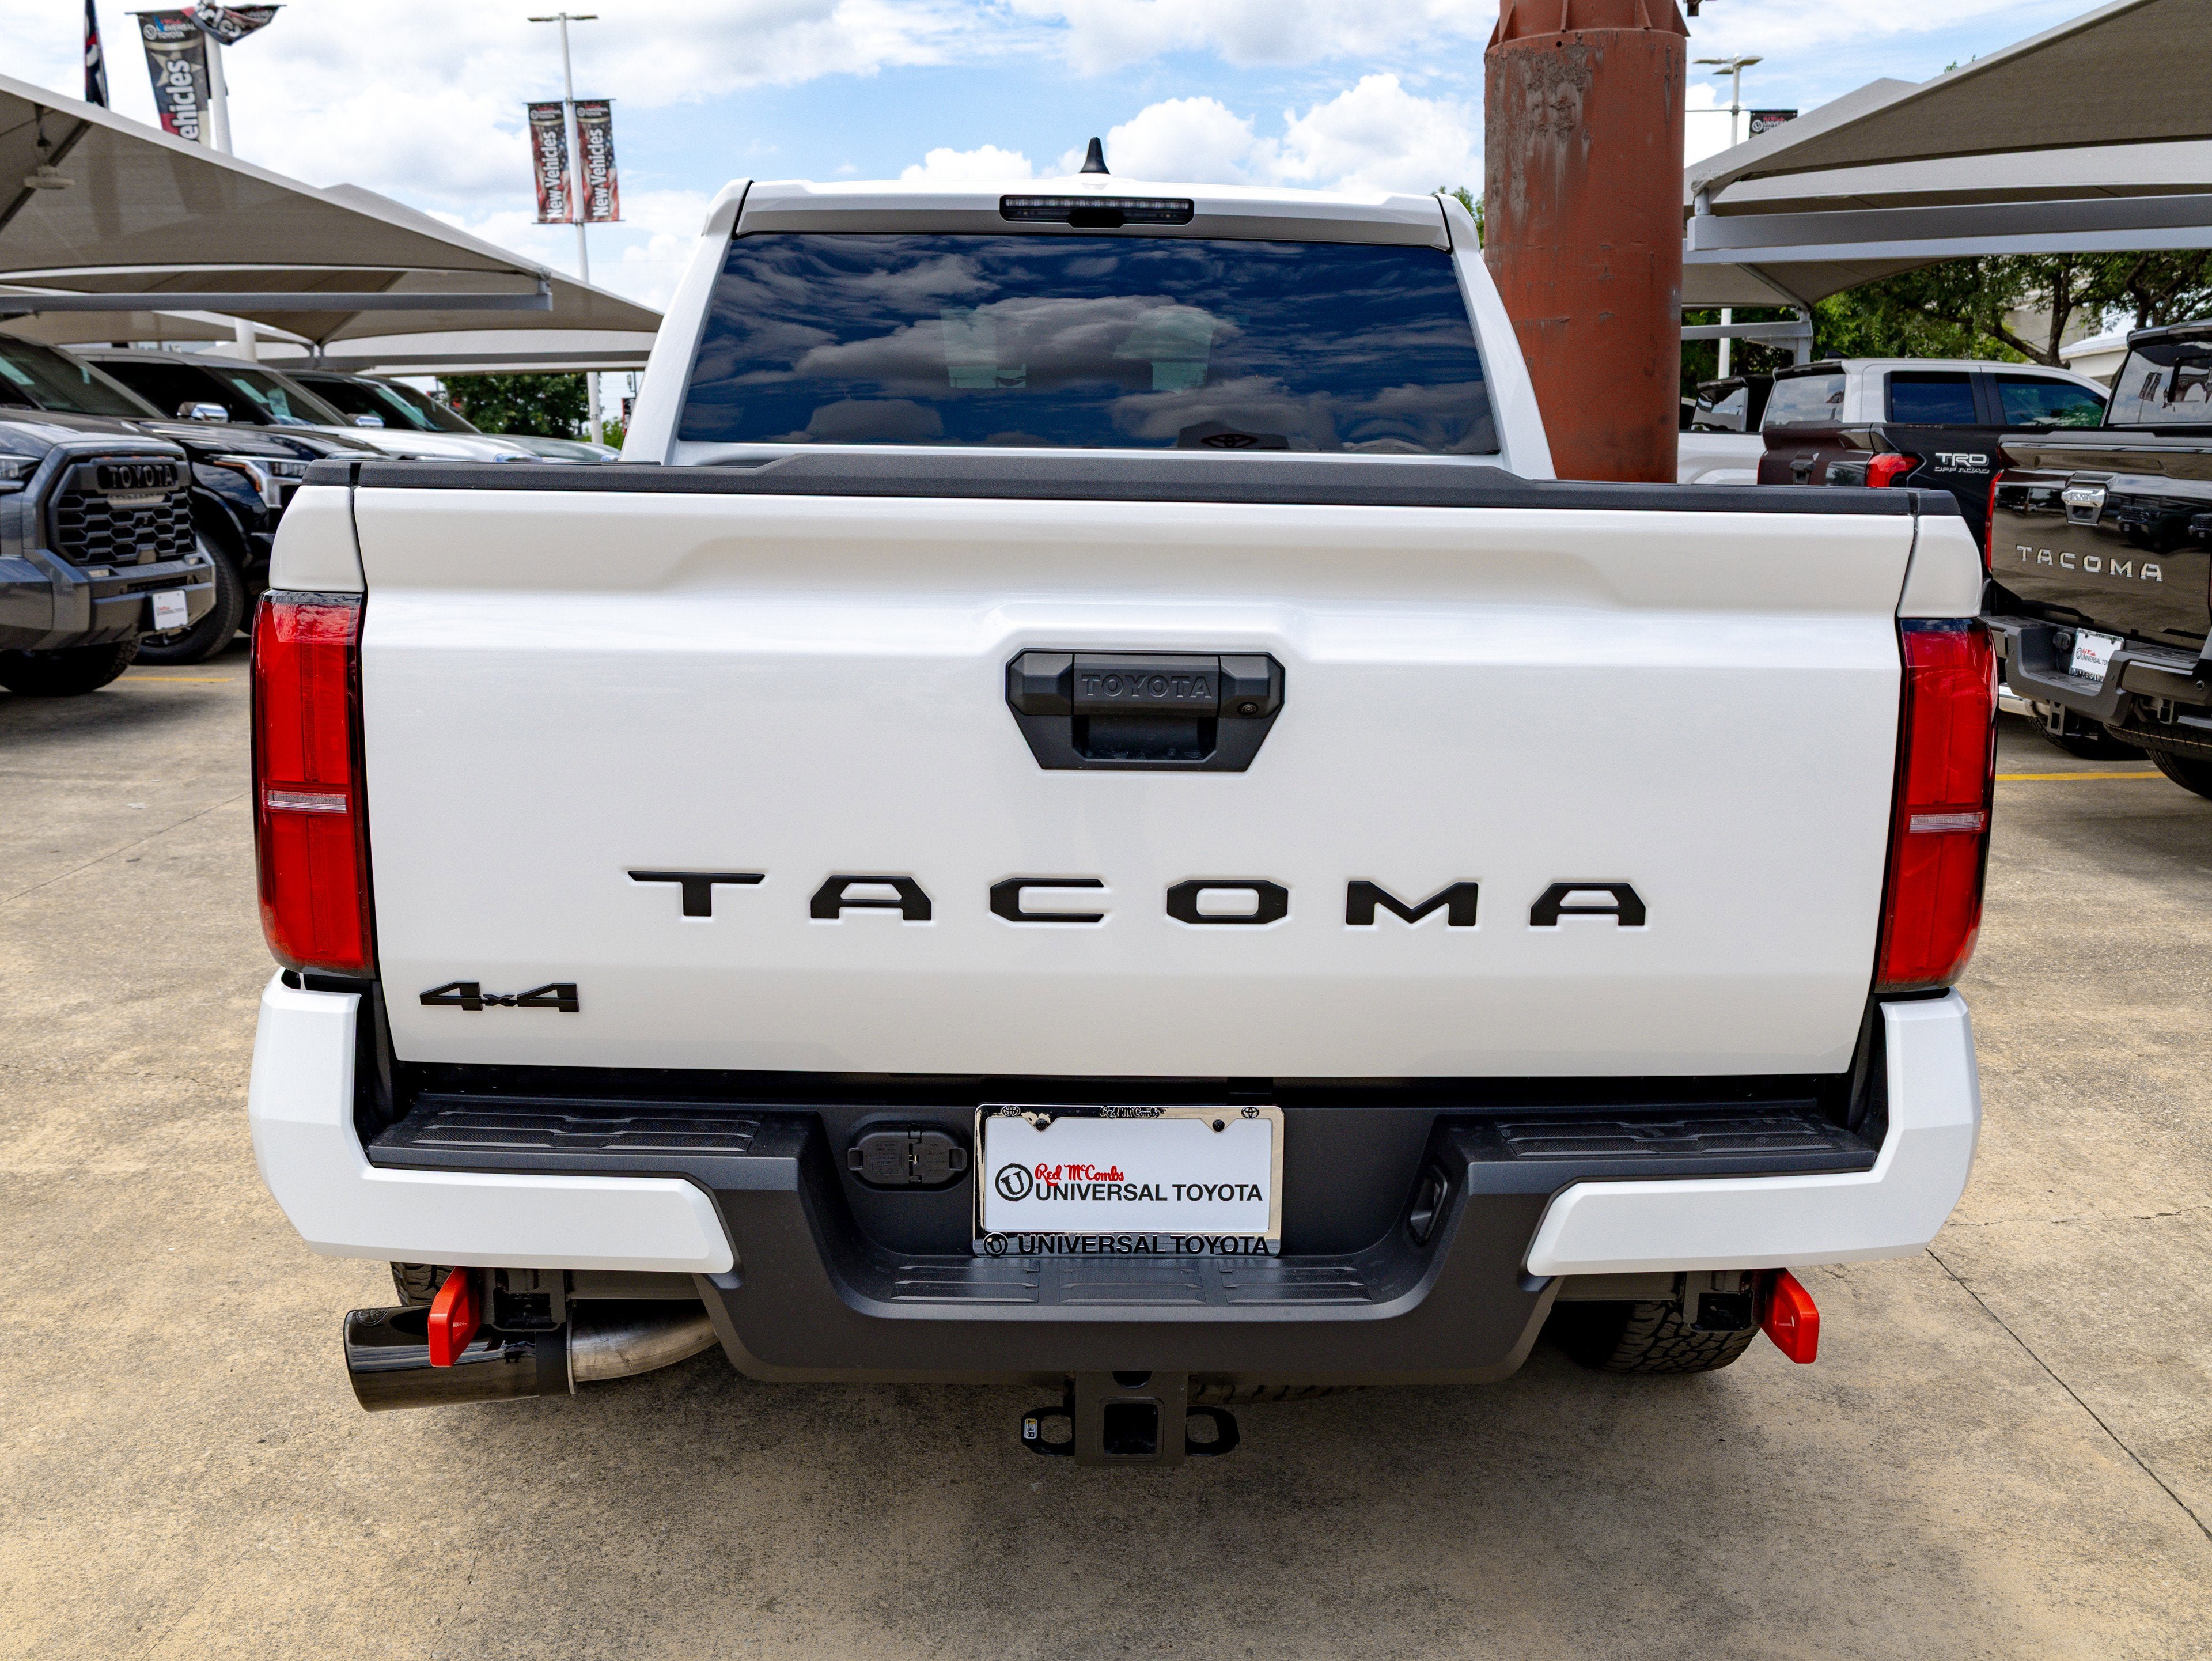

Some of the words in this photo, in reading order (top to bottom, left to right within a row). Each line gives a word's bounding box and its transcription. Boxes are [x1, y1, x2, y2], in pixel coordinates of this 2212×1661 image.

[166, 59, 200, 142] ehicles
[540, 131, 562, 188] Vehicles
[587, 128, 608, 186] Vehicles
[547, 189, 563, 218] New
[592, 187, 609, 217] New
[1935, 452, 1989, 467] TRD
[107, 465, 174, 489] TOYOTA
[2016, 544, 2163, 582] TACOMA
[1081, 674, 1213, 698] TOYOTA
[627, 870, 1646, 927] TACOMA
[1035, 1163, 1062, 1187] Red
[1064, 1164, 1124, 1182] McCombs
[1036, 1183, 1168, 1201] UNIVERSAL
[1172, 1183, 1263, 1201] TOYOTA
[1018, 1234, 1165, 1254] UNIVERSAL
[1170, 1235, 1270, 1255] TOYOTA
